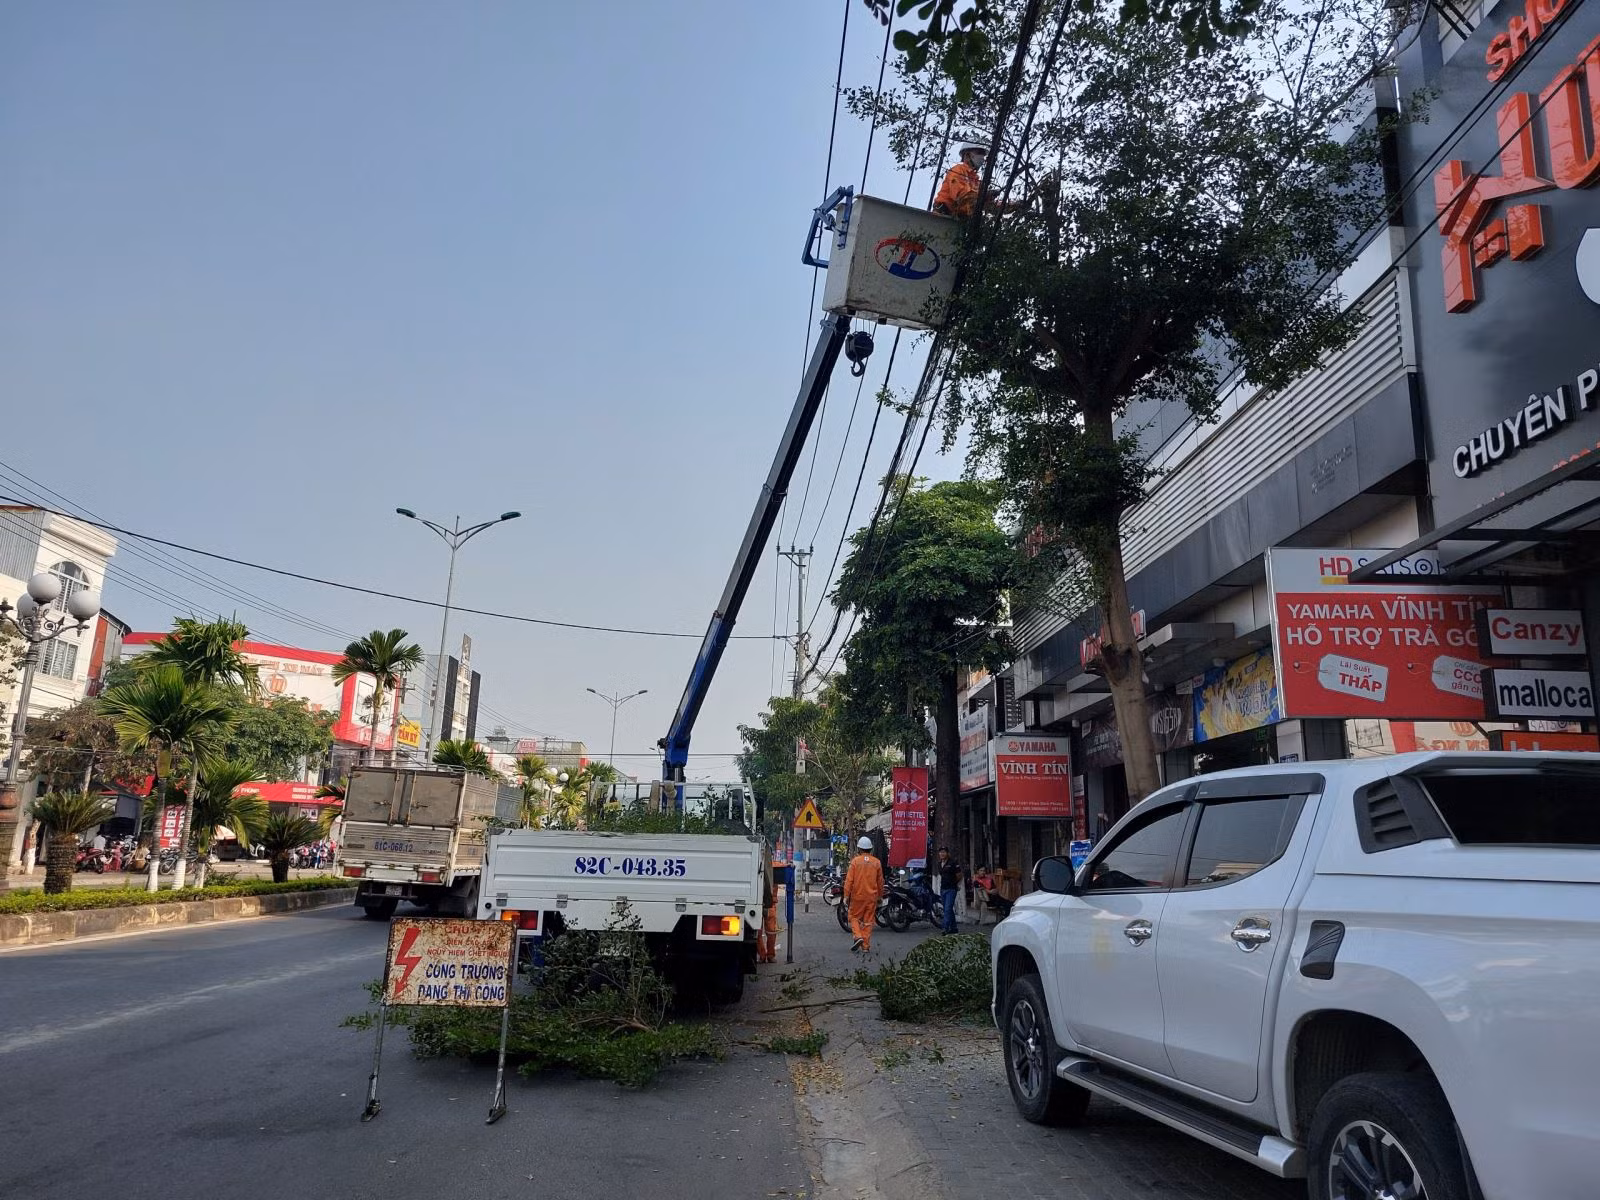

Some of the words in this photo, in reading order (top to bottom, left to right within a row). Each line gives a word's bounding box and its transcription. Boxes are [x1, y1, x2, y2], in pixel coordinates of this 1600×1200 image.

[1453, 387, 1567, 478] CHUYÊN
[1577, 363, 1600, 410] P
[1319, 557, 1352, 576] HD
[1287, 604, 1375, 619] YAMAHA
[1381, 596, 1445, 620] VĨNH
[1286, 623, 1323, 646] HỖ
[1329, 627, 1382, 650] TRỢ
[1389, 624, 1440, 646] TRẢ
[1491, 617, 1580, 647] Canzy
[1339, 672, 1383, 693] THẤP
[1499, 678, 1593, 708] malloca
[1020, 741, 1056, 753] YAMAHA
[1042, 760, 1068, 775] TÍN
[574, 856, 686, 877] 82C-043.35
